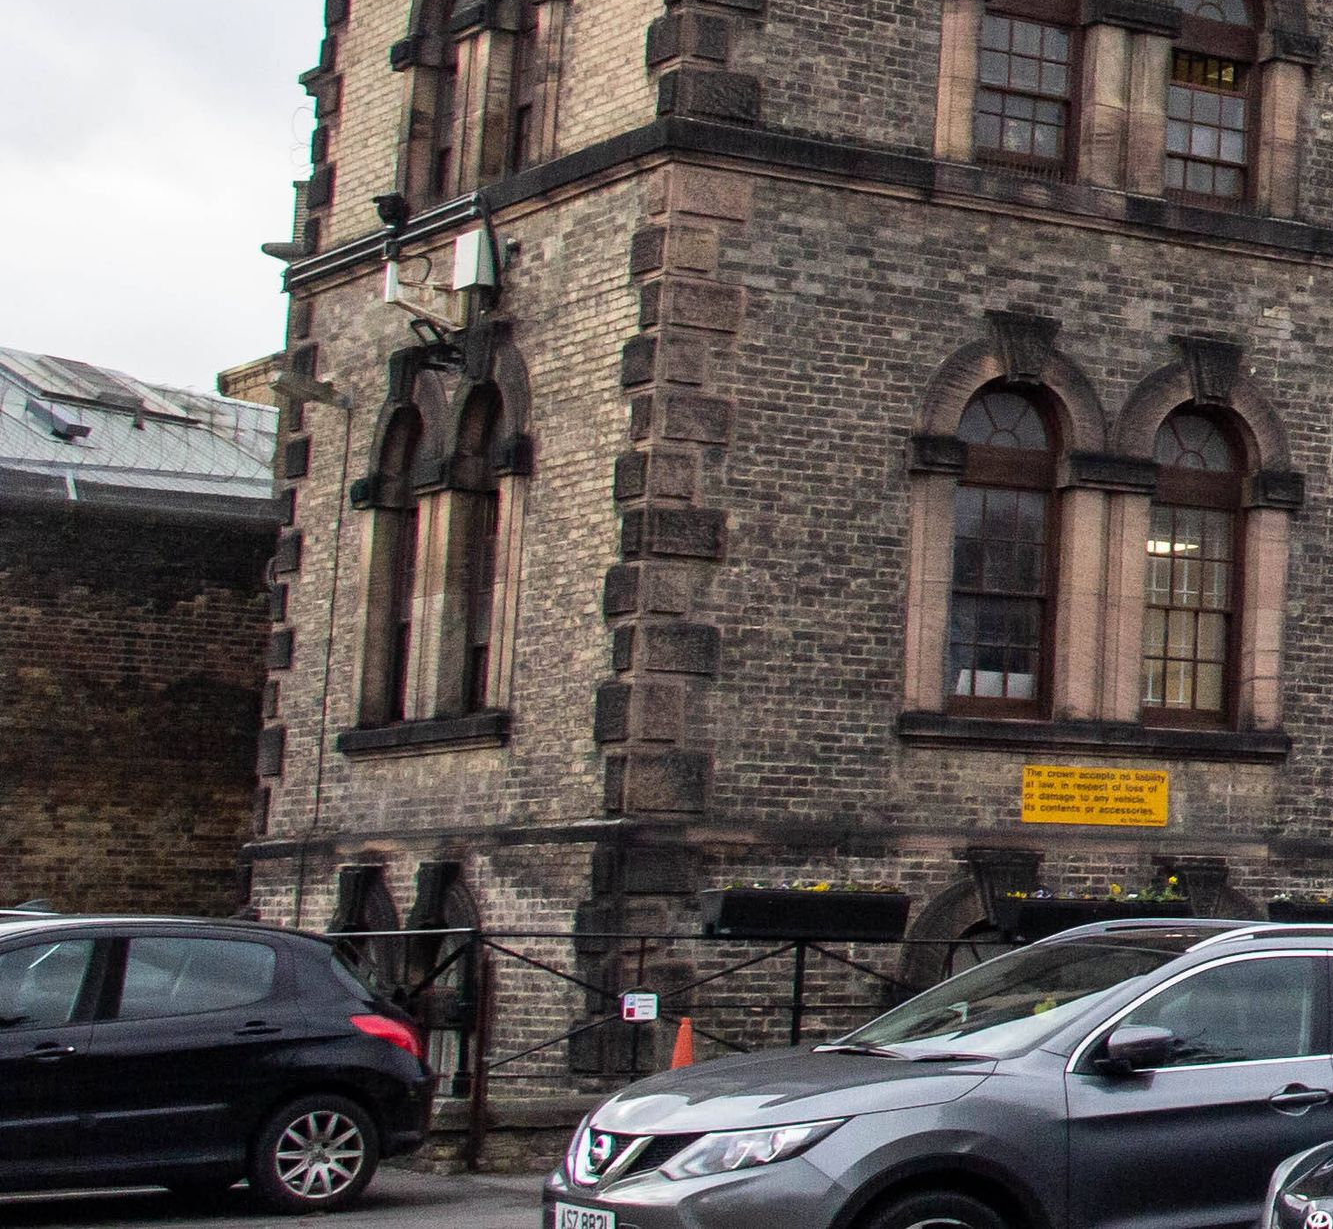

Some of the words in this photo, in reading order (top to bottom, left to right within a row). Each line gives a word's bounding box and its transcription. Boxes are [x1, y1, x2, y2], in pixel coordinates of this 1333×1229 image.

[1026, 768, 1042, 777] The
[1135, 772, 1166, 783] liability
[1061, 781, 1069, 789] in
[1073, 783, 1107, 792] respect
[1112, 783, 1121, 791] of
[1126, 784, 1144, 792] loss
[1039, 793, 1075, 803] damage
[1080, 794, 1089, 802] to
[1094, 795, 1109, 804] any
[1040, 804, 1080, 812] contents
